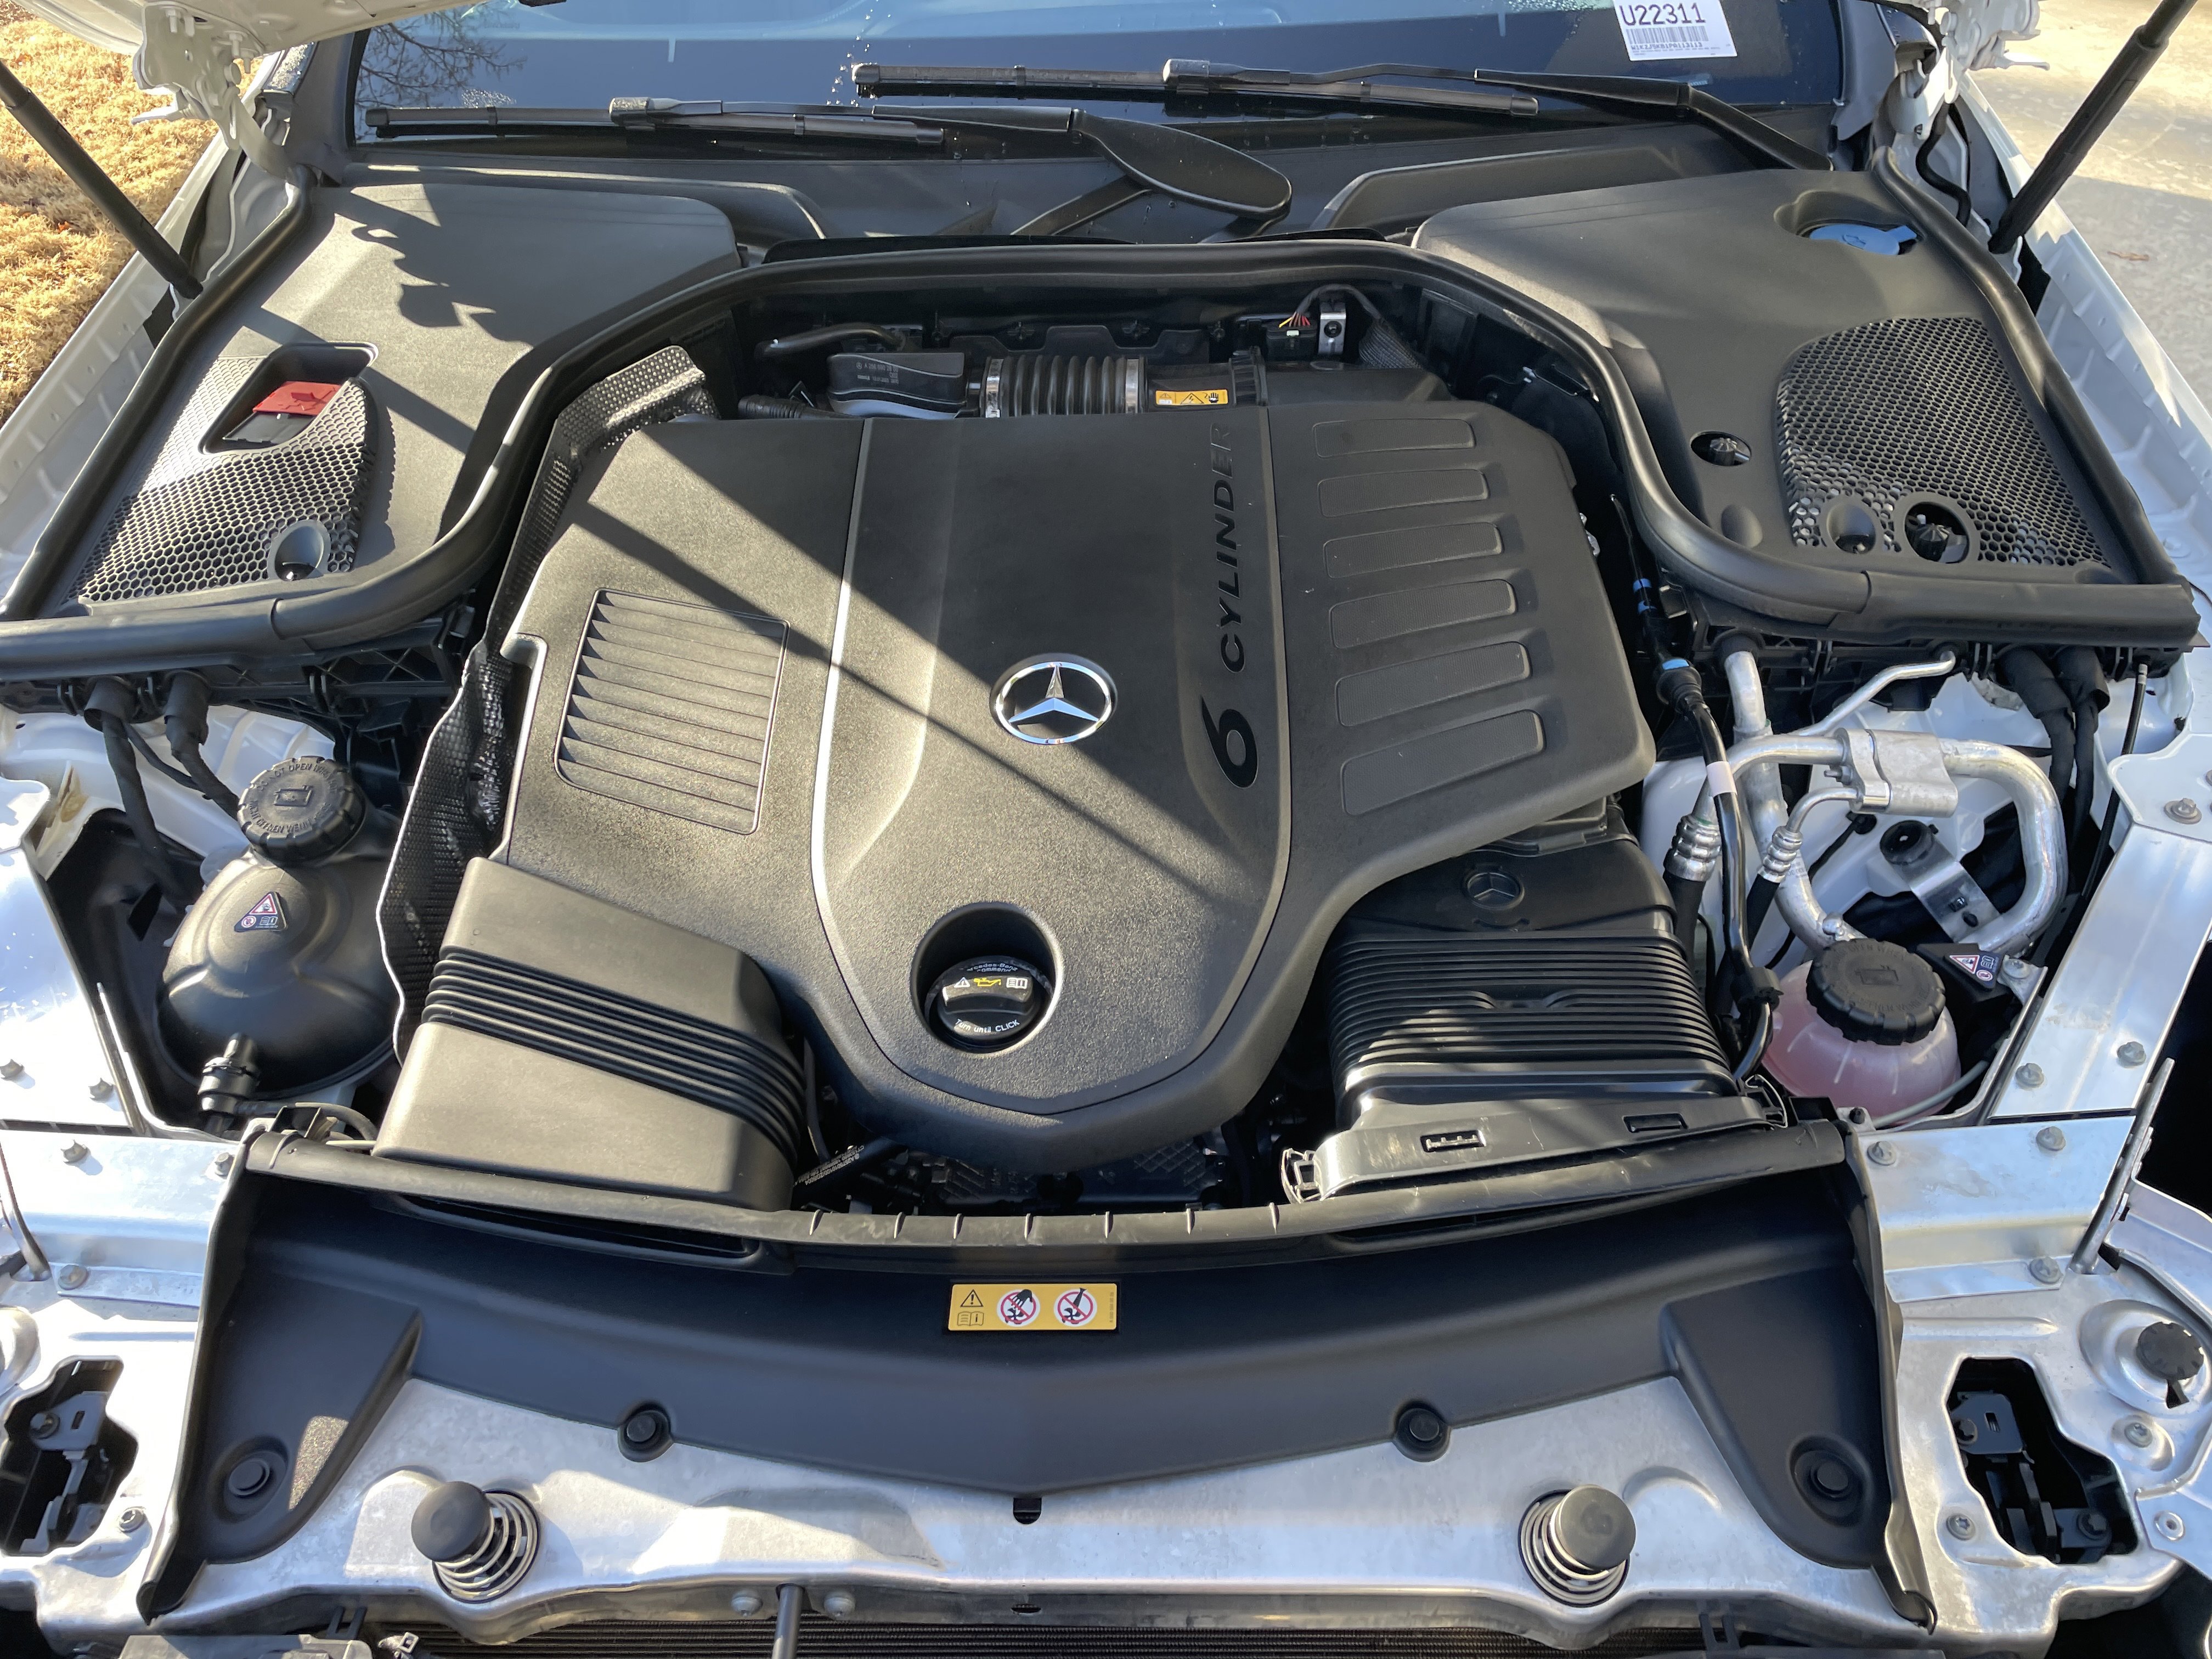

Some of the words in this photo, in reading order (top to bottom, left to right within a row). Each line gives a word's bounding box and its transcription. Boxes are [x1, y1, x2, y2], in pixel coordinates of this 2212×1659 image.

[1619, 3, 1706, 26] U22311
[1210, 423, 1246, 673] CYLINDER
[1200, 694, 1259, 789] 6
[289, 763, 313, 772] OPEN
[955, 1018, 971, 1031] Turn
[995, 1019, 1020, 1032] CLICK
